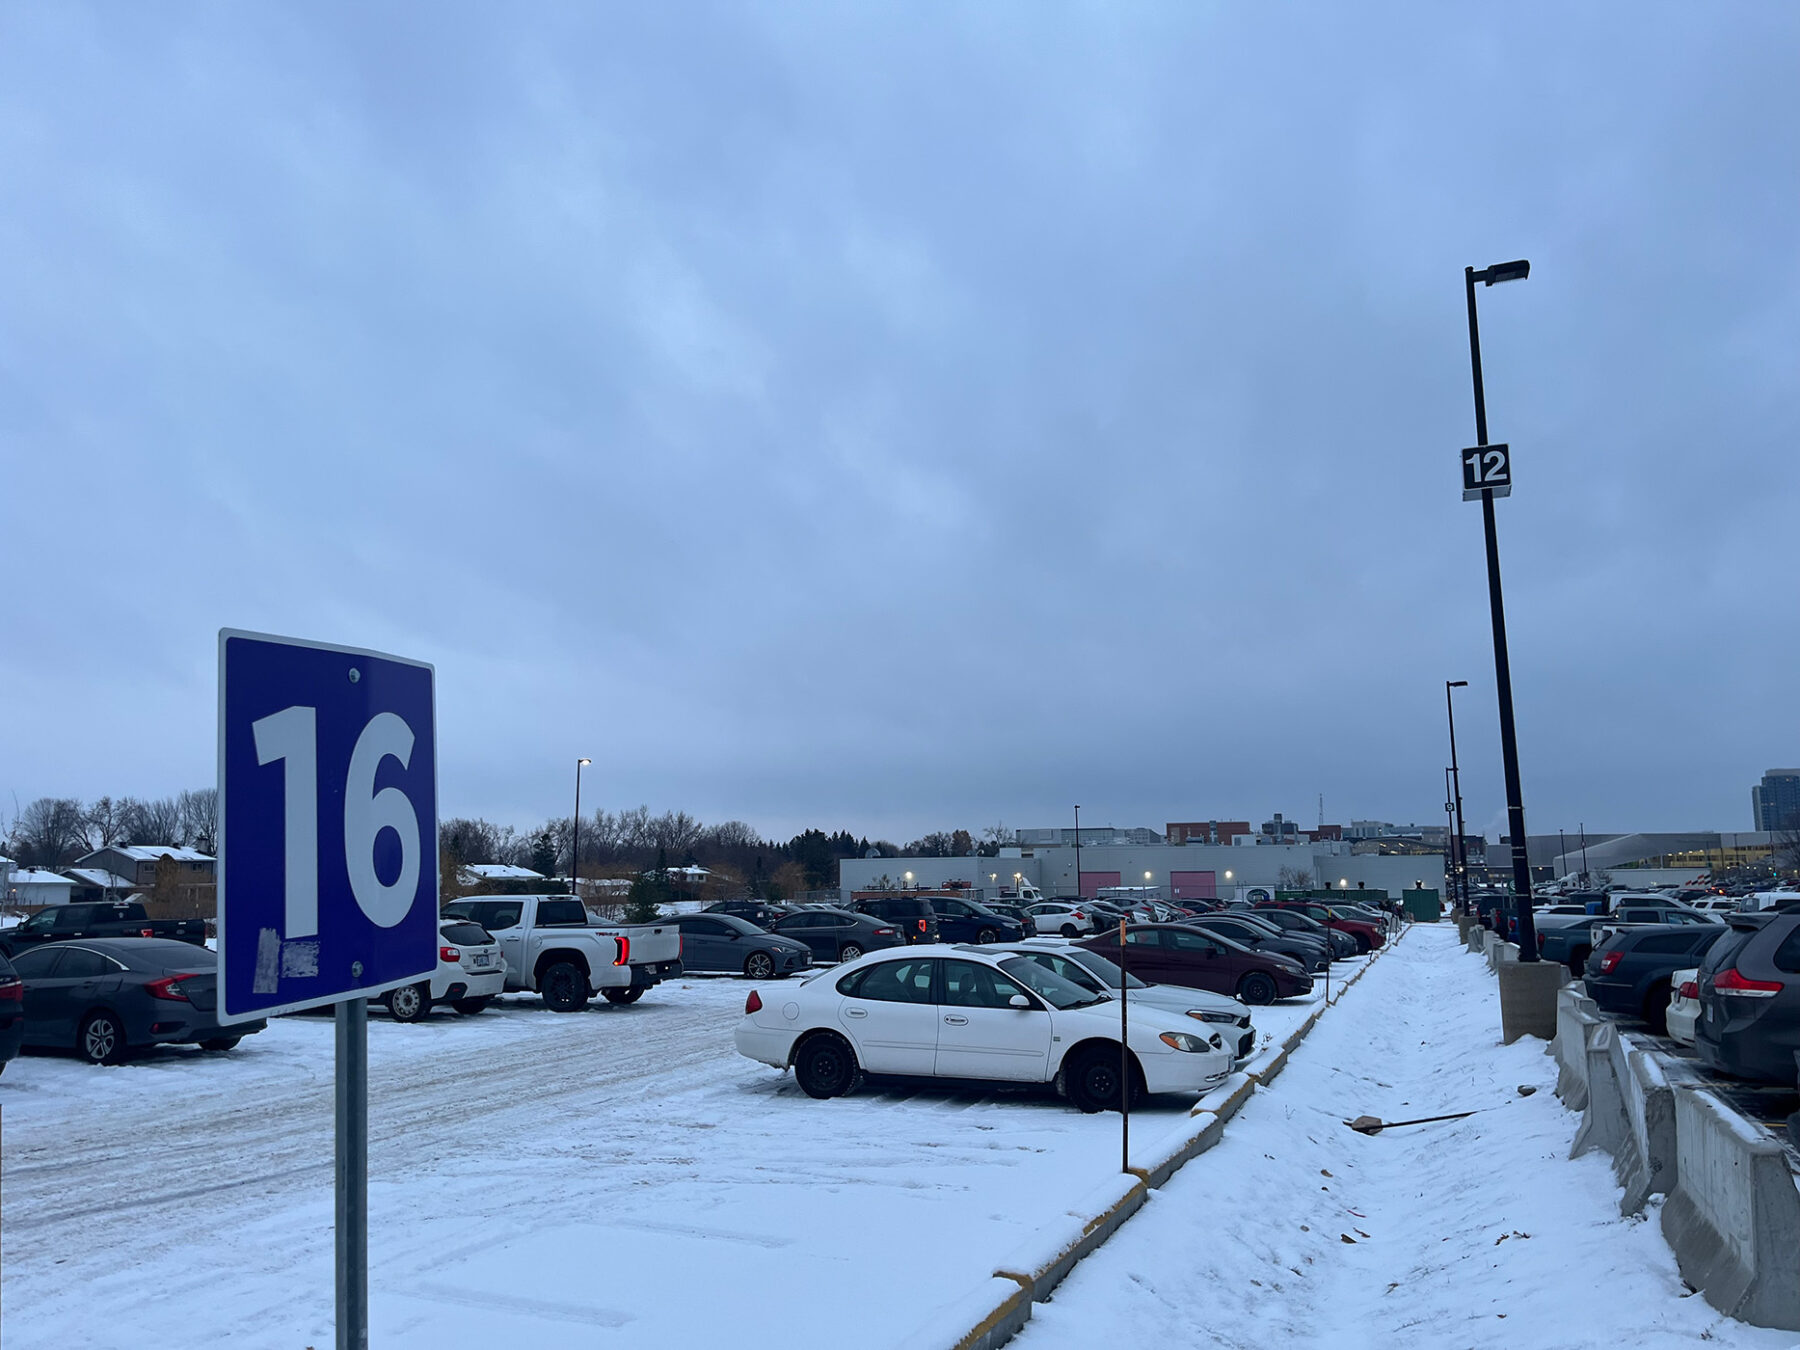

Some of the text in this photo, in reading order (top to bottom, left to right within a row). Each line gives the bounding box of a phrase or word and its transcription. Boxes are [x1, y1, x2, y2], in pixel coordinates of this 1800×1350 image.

[1465, 450, 1507, 483] 12
[251, 705, 421, 939] 16
[1446, 803, 1453, 811] 9
